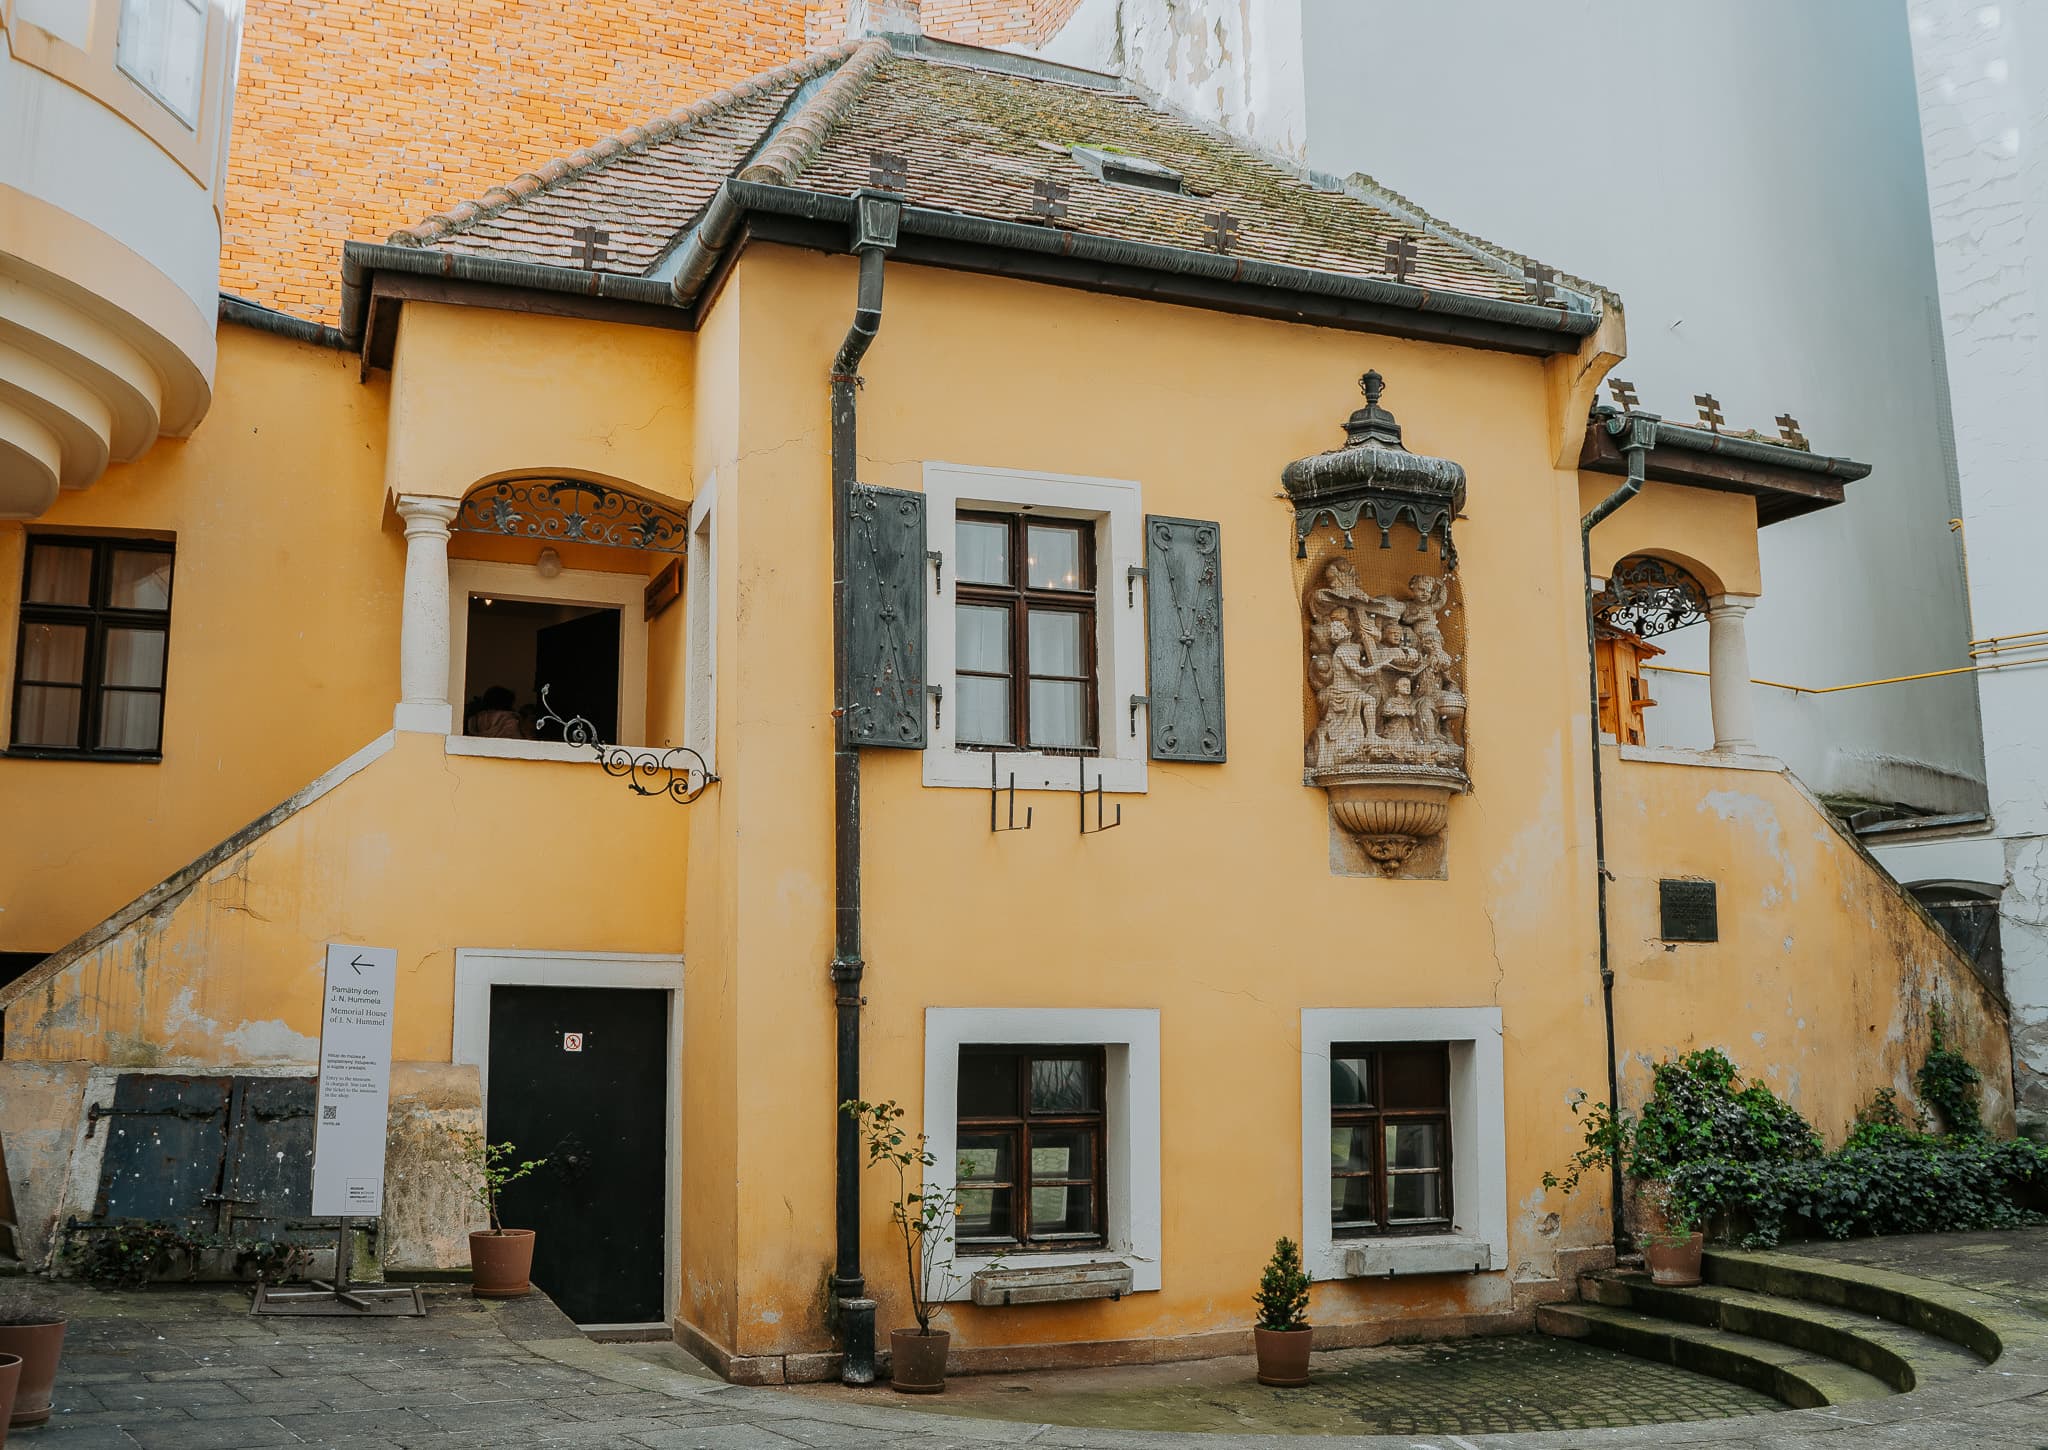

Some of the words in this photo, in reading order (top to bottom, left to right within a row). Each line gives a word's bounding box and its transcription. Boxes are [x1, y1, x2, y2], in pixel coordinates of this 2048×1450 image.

[362, 988, 379, 996] dom
[339, 995, 346, 1003] N.
[347, 996, 381, 1005] Hummela
[330, 1007, 364, 1016] Memorial
[365, 1009, 388, 1018] House
[329, 1016, 338, 1024] of
[355, 1018, 385, 1026] Hummel
